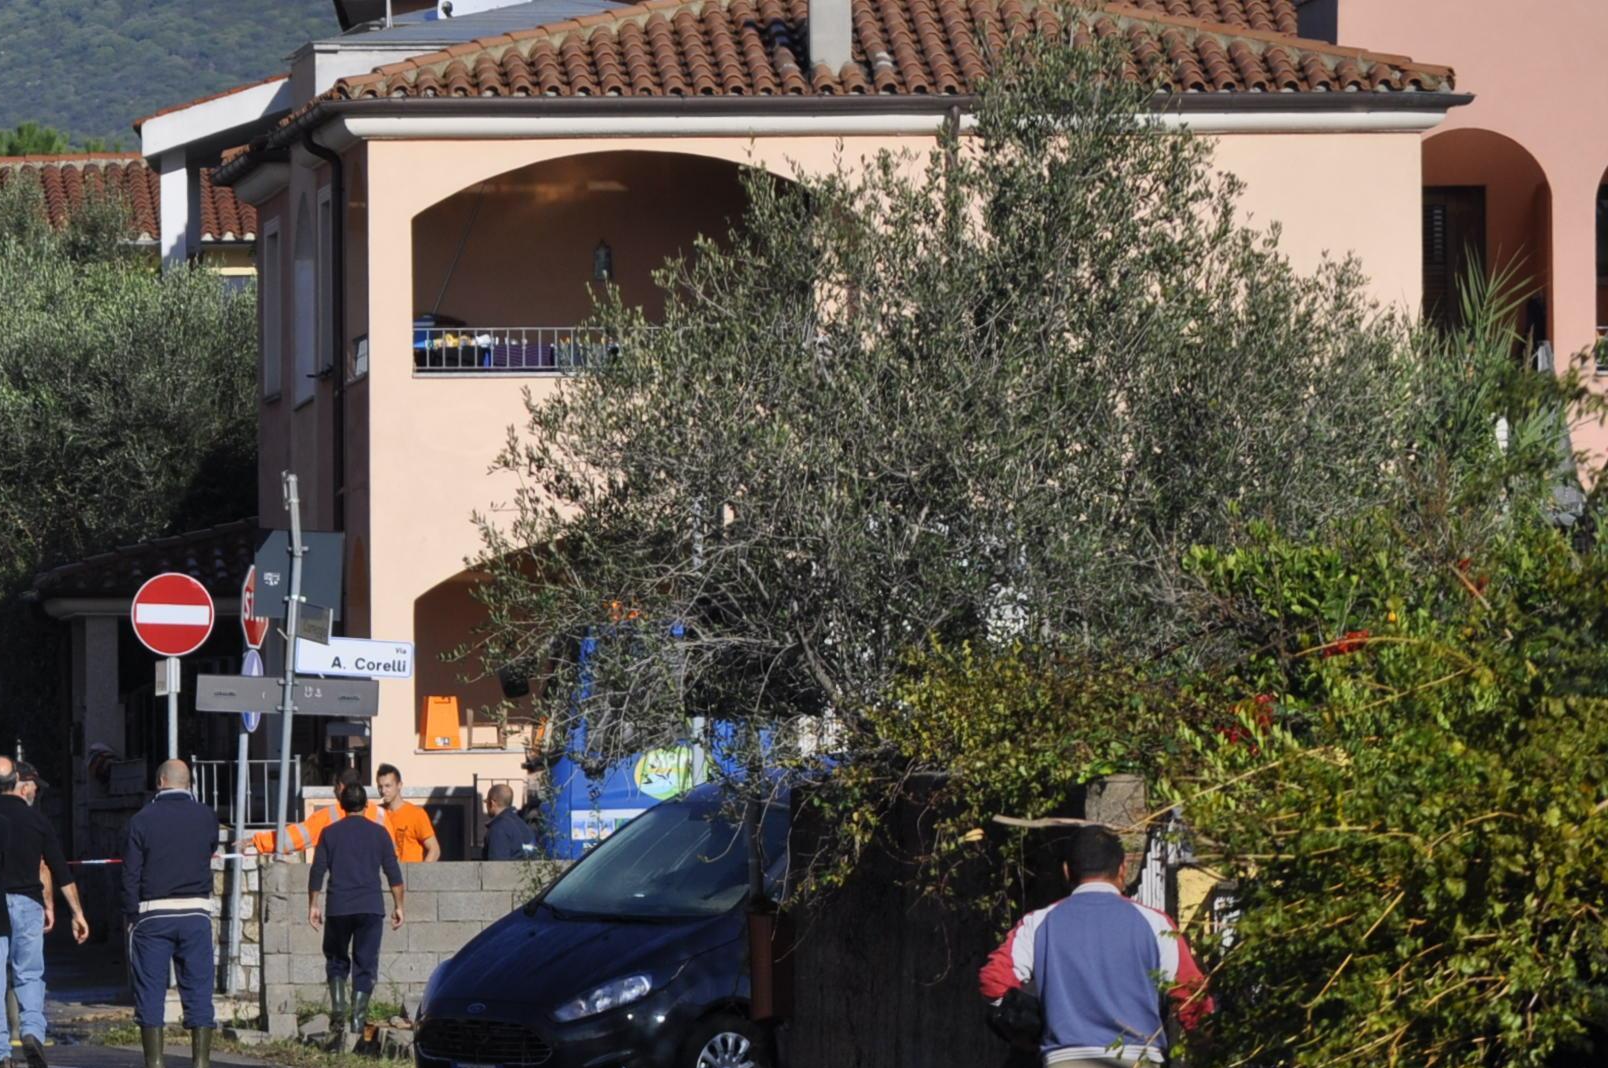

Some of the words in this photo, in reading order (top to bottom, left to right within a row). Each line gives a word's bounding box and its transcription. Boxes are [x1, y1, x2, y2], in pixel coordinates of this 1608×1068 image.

[395, 647, 407, 655] Via
[331, 656, 346, 670] A.
[354, 657, 407, 673] Corelli
